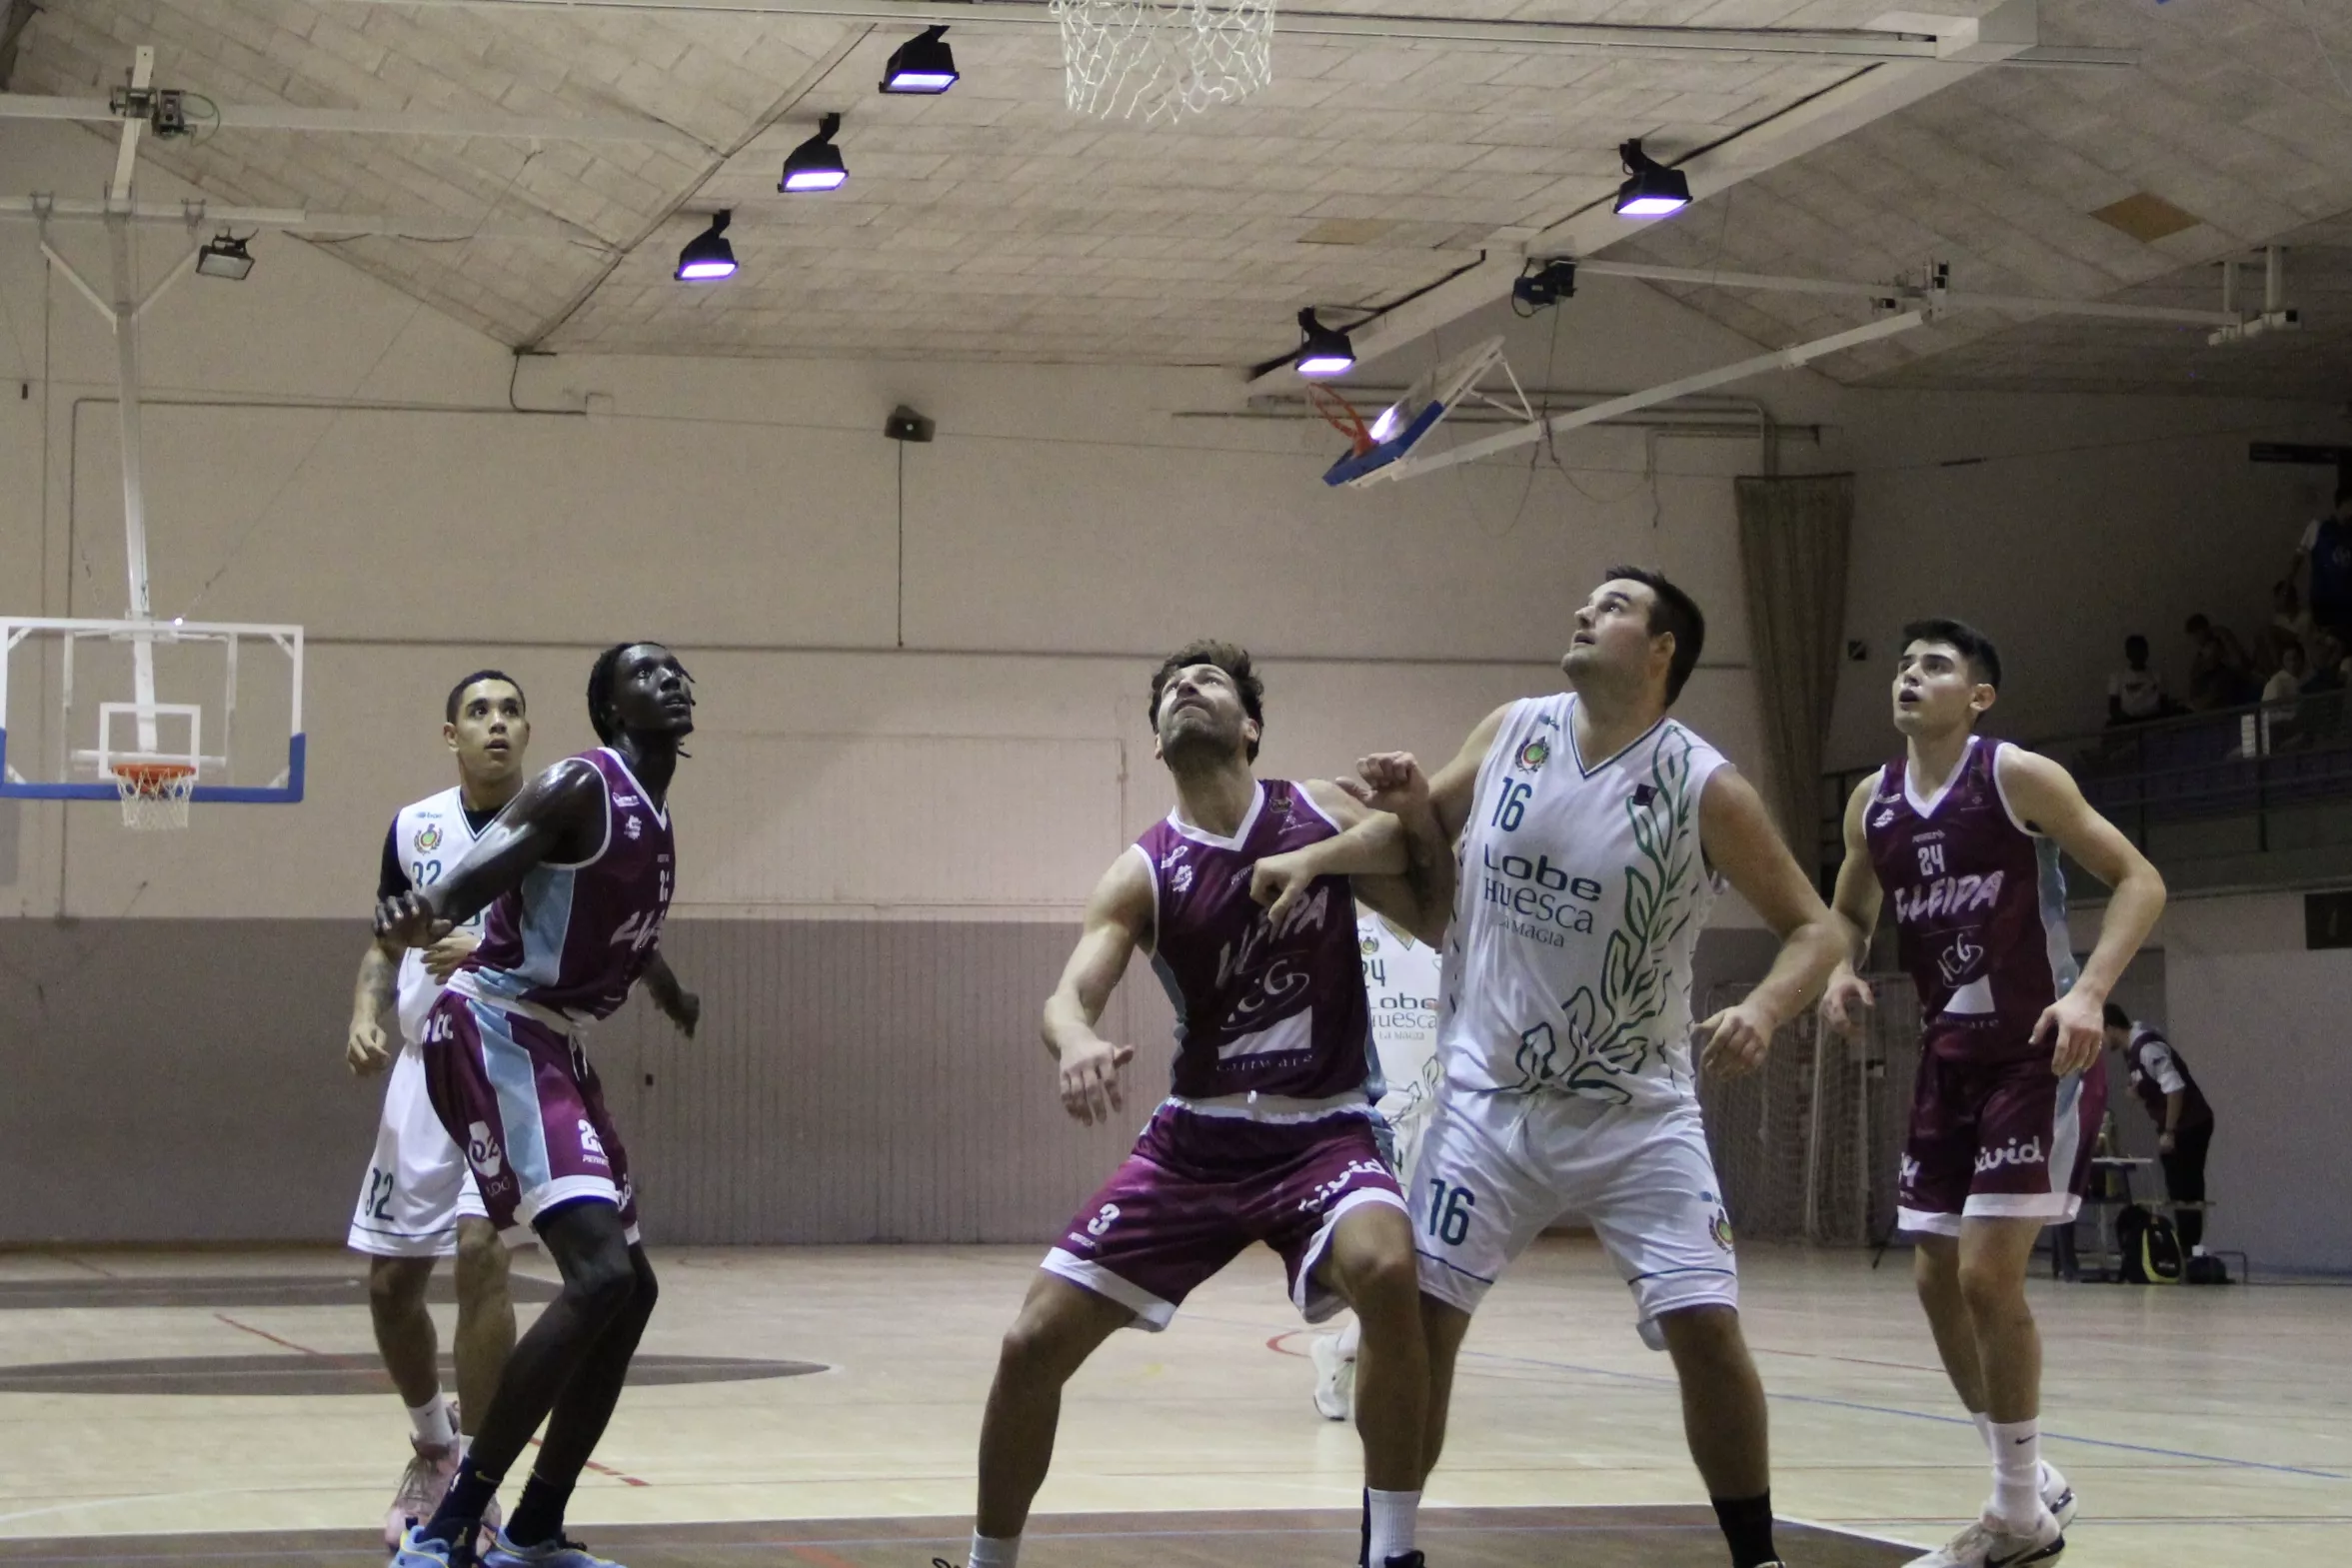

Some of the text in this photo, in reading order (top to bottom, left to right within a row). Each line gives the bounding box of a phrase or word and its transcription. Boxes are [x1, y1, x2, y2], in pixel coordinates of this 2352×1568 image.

[1491, 777, 1532, 832] 16
[1484, 842, 1602, 902] Lobe
[1917, 842, 1946, 876] 24
[1894, 870, 2004, 923] LLEIDA
[1370, 992, 1438, 1009] obe
[1899, 1151, 1920, 1187] 4
[1088, 1203, 1121, 1235] 3
[1428, 1178, 1475, 1247] 16
